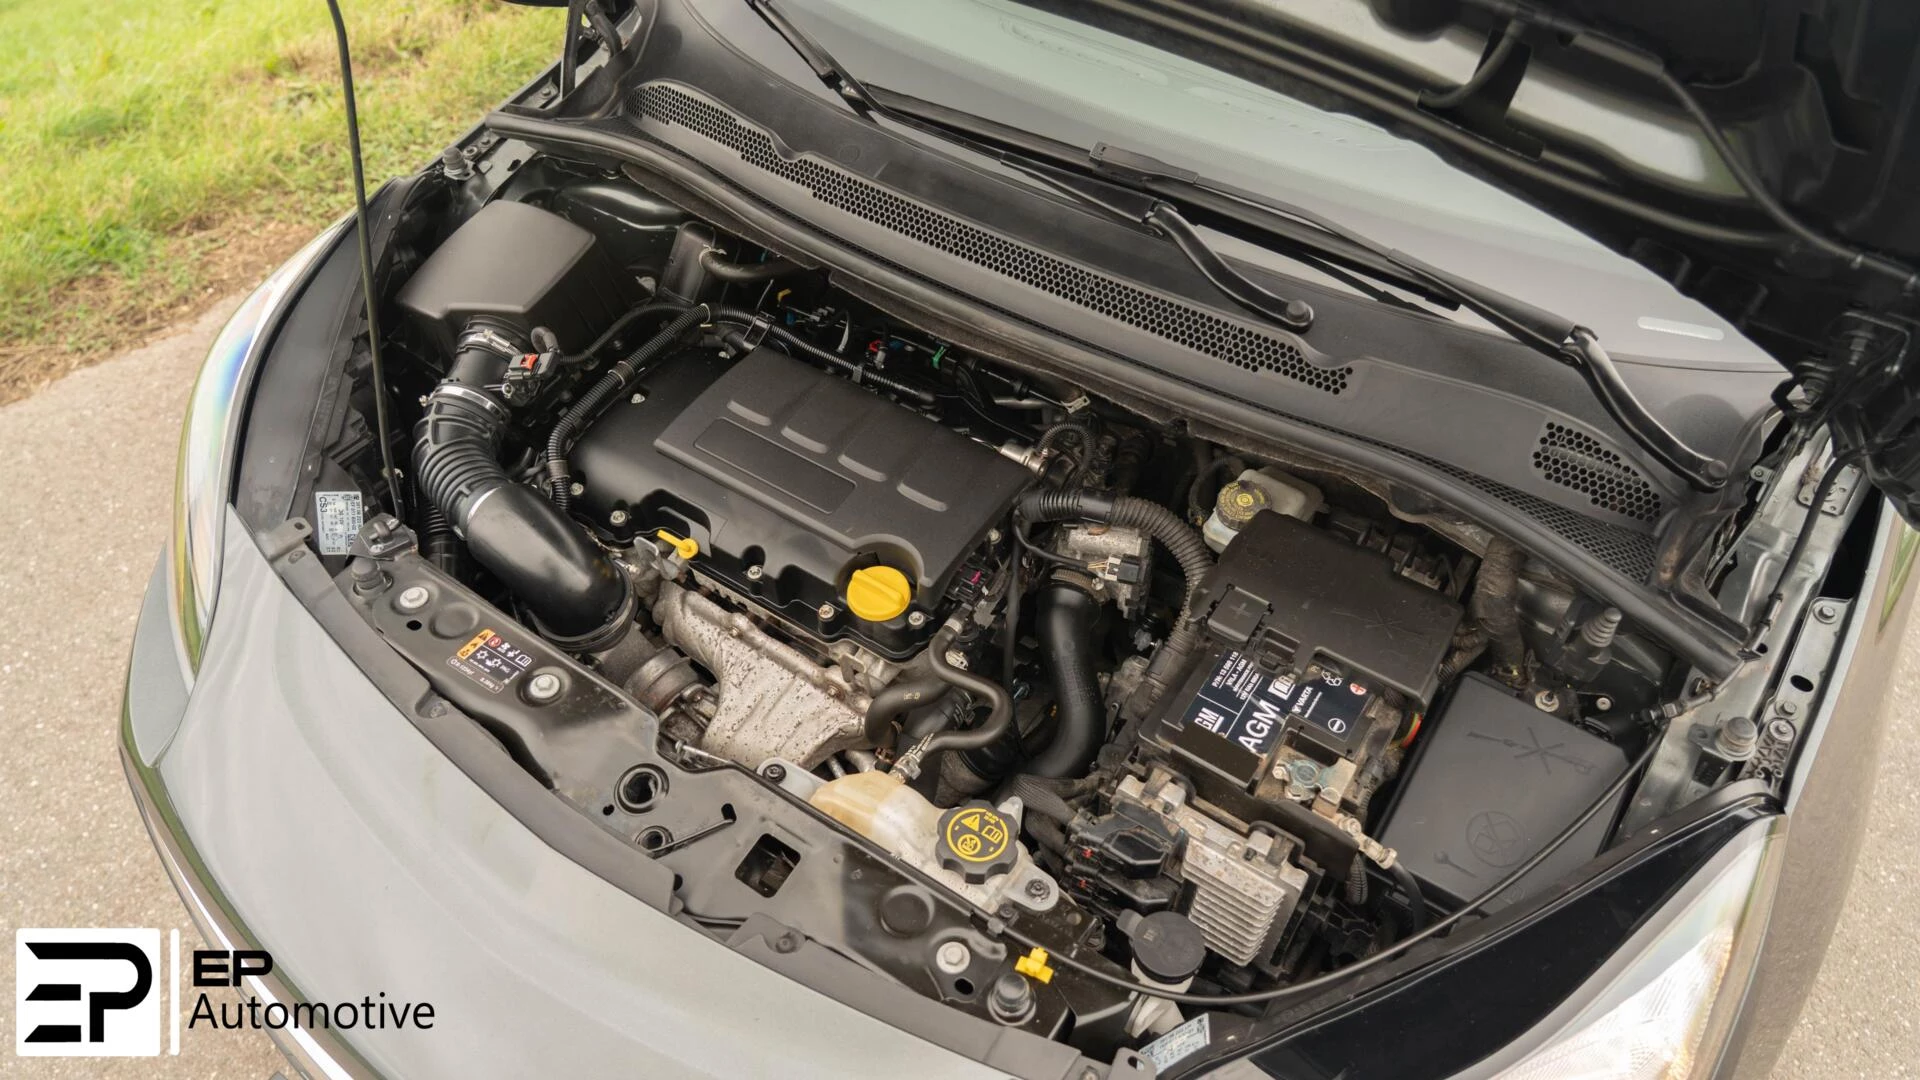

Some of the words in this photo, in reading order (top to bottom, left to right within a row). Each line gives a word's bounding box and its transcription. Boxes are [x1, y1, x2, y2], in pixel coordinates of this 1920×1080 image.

[319, 496, 328, 513] CS3
[1296, 686, 1314, 706] VARTA
[1194, 707, 1220, 731] GM
[1238, 699, 1280, 753] AGM
